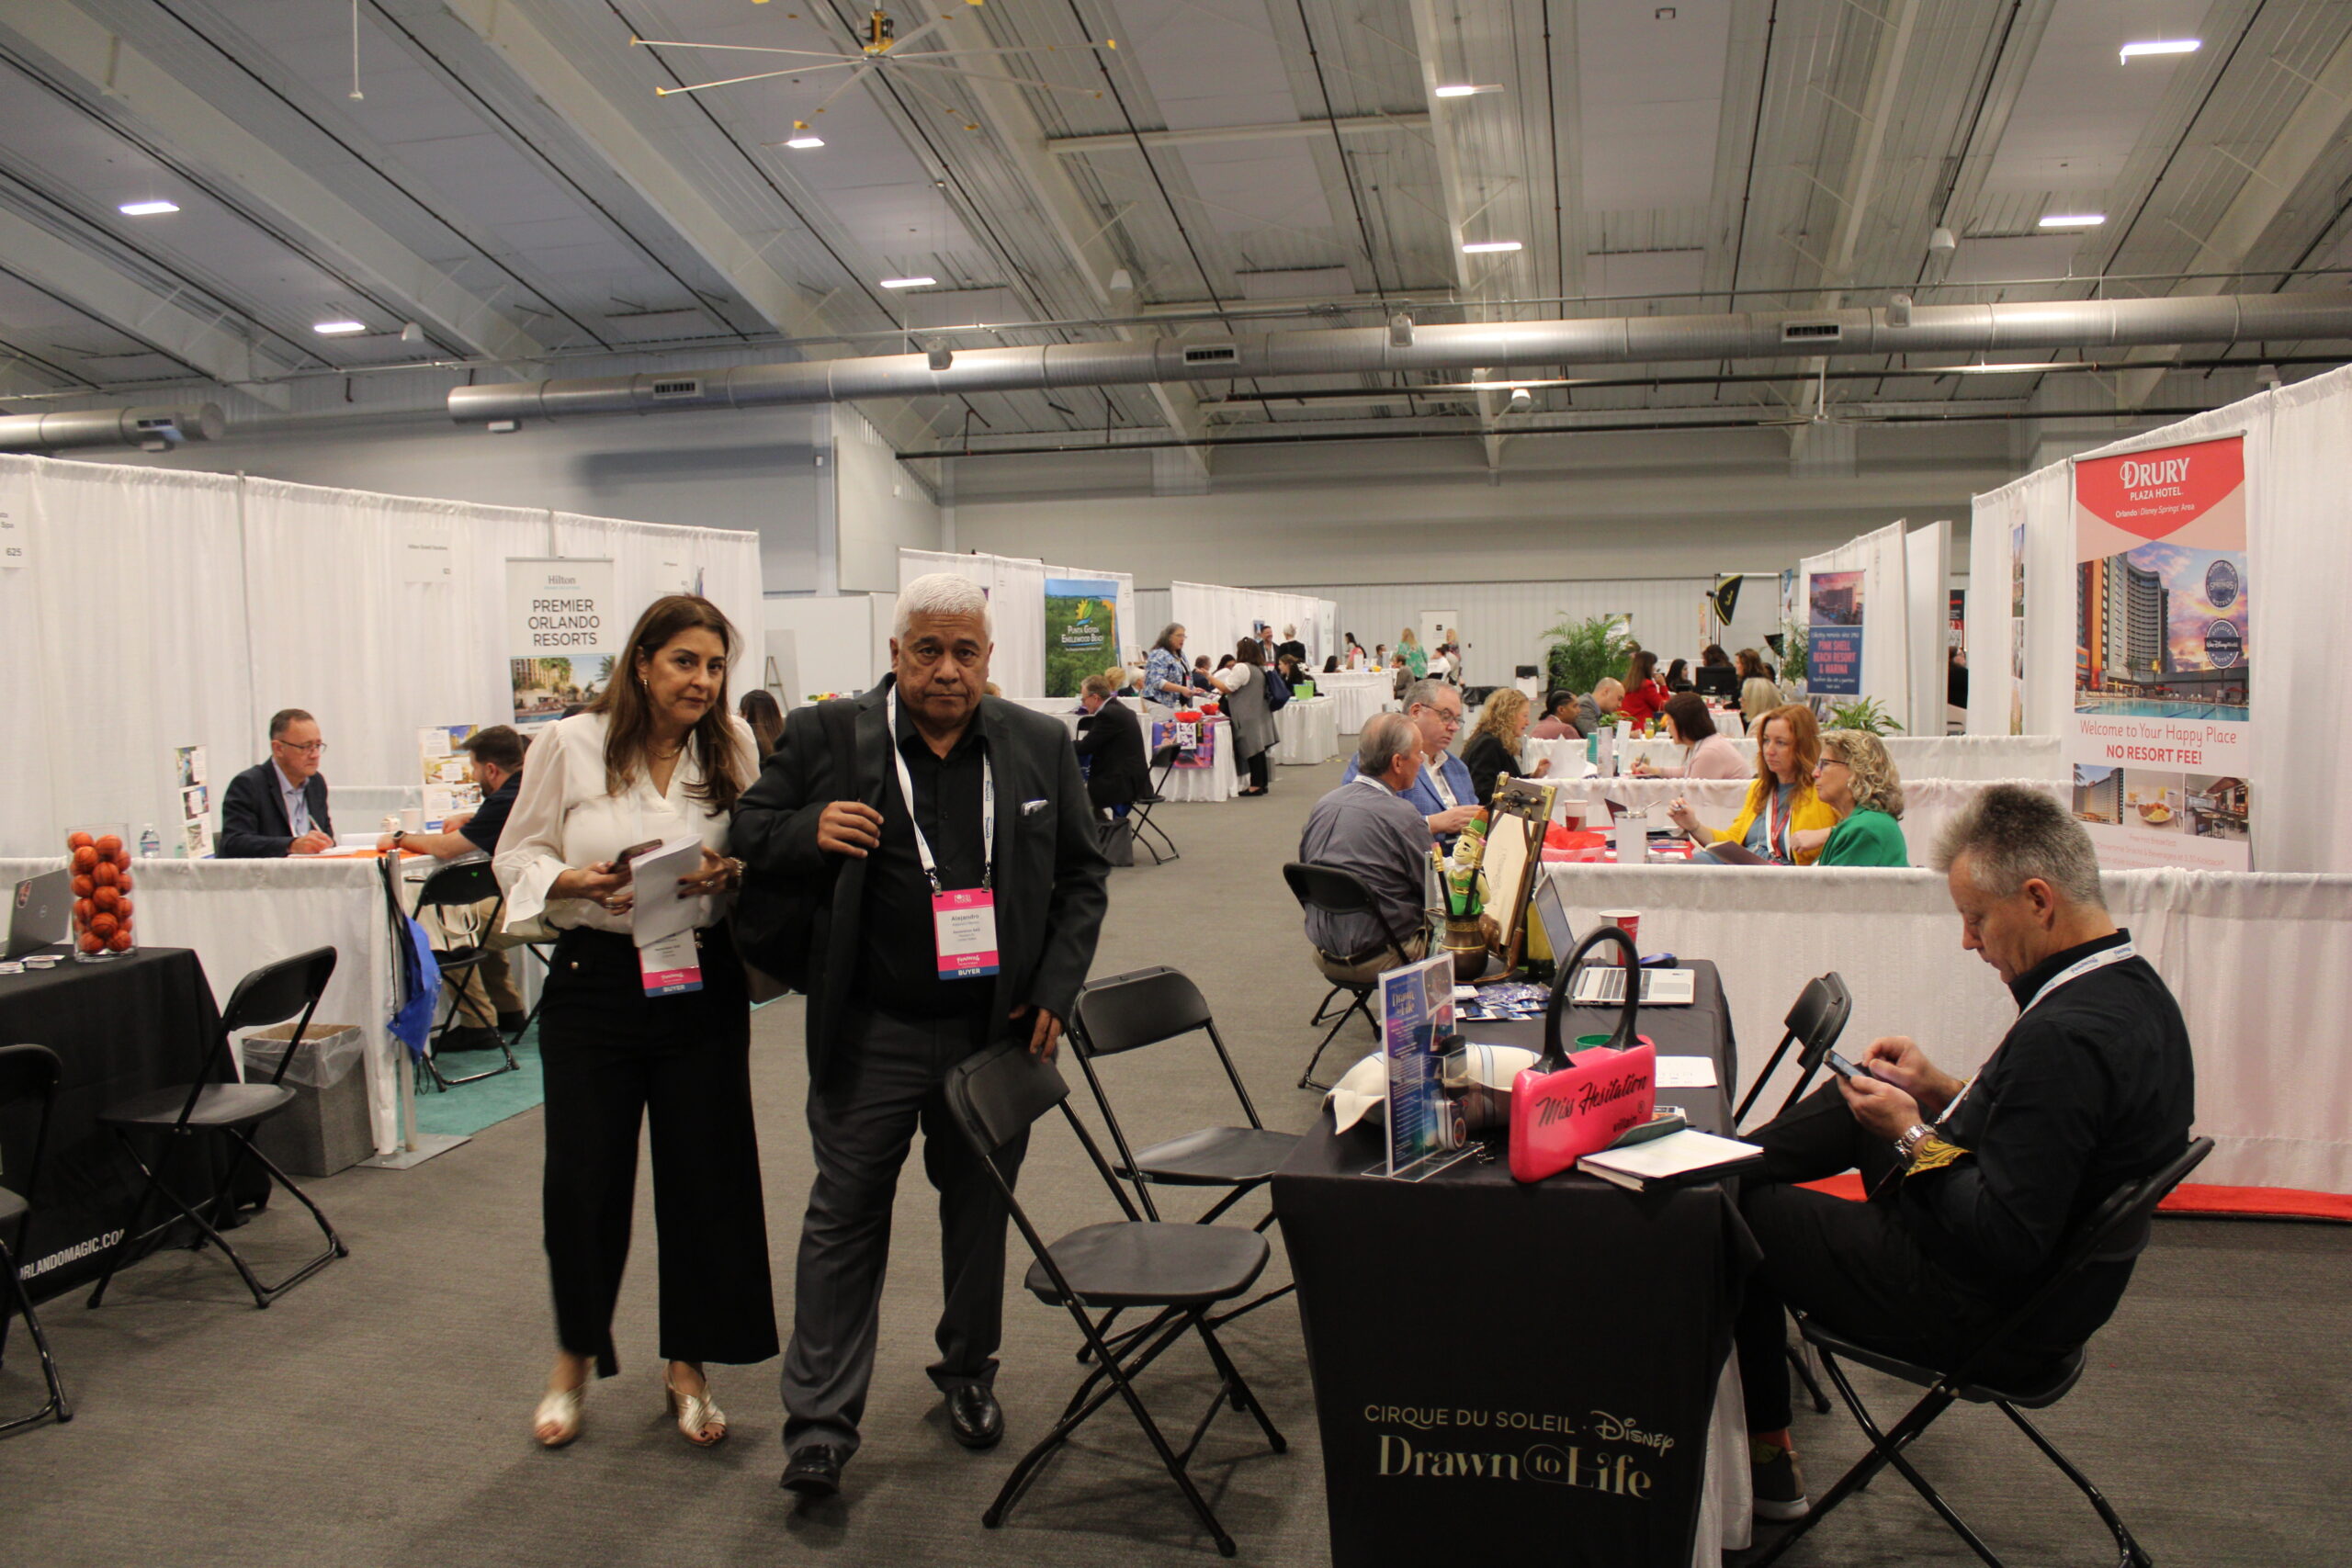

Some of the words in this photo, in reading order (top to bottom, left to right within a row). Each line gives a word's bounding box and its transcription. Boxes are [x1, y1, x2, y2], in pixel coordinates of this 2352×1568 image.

[2120, 457, 2190, 489] DRURY
[2130, 489, 2154, 502] PLAZA
[2115, 509, 2138, 519] Orlando
[2140, 506, 2157, 517] Disney
[2158, 504, 2179, 515] Springs
[2181, 503, 2195, 512] Area
[548, 575, 577, 585] Hilton
[532, 599, 594, 613] PREMIER
[527, 615, 600, 630] ORLANDO
[533, 632, 597, 647] RESORTS
[2080, 719, 2123, 737] Welcome
[2127, 724, 2137, 738] to
[2139, 722, 2162, 739] Your
[2165, 724, 2202, 748] Happy
[2206, 726, 2237, 744] Place
[2107, 745, 2124, 759] NO
[2127, 746, 2174, 762] RESORT
[2177, 750, 2202, 764] FEE!
[951, 914, 979, 922] Alejandro
[958, 967, 980, 976] BUYER
[1536, 1096, 1575, 1127] Miss
[1578, 1074, 1647, 1115] Hesitation
[1364, 1404, 1448, 1430] CIRQUE
[1456, 1409, 1488, 1427] DU
[1496, 1411, 1576, 1434] SOLEIL
[1377, 1434, 1521, 1481] Drawn
[1535, 1454, 1561, 1475] to
[1567, 1445, 1652, 1499] Life
